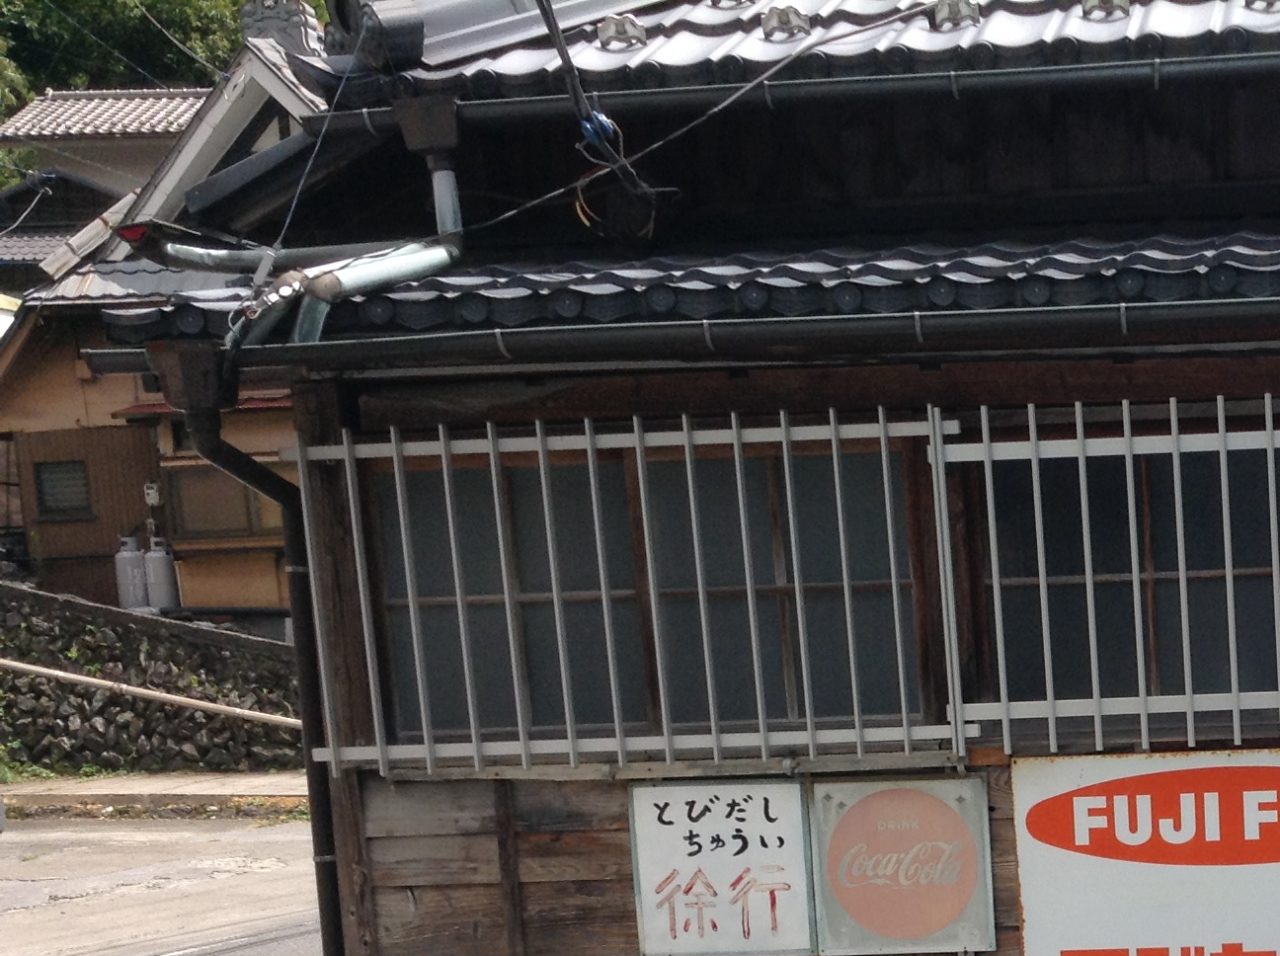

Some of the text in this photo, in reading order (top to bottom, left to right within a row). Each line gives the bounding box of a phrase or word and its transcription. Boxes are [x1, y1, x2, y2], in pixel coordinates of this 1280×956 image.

[653, 795, 779, 826] とびだし
[876, 819, 920, 831] DRINK
[1073, 792, 1220, 846] FUJI
[682, 828, 785, 857] ちゅうい
[654, 864, 792, 940] 徐行
